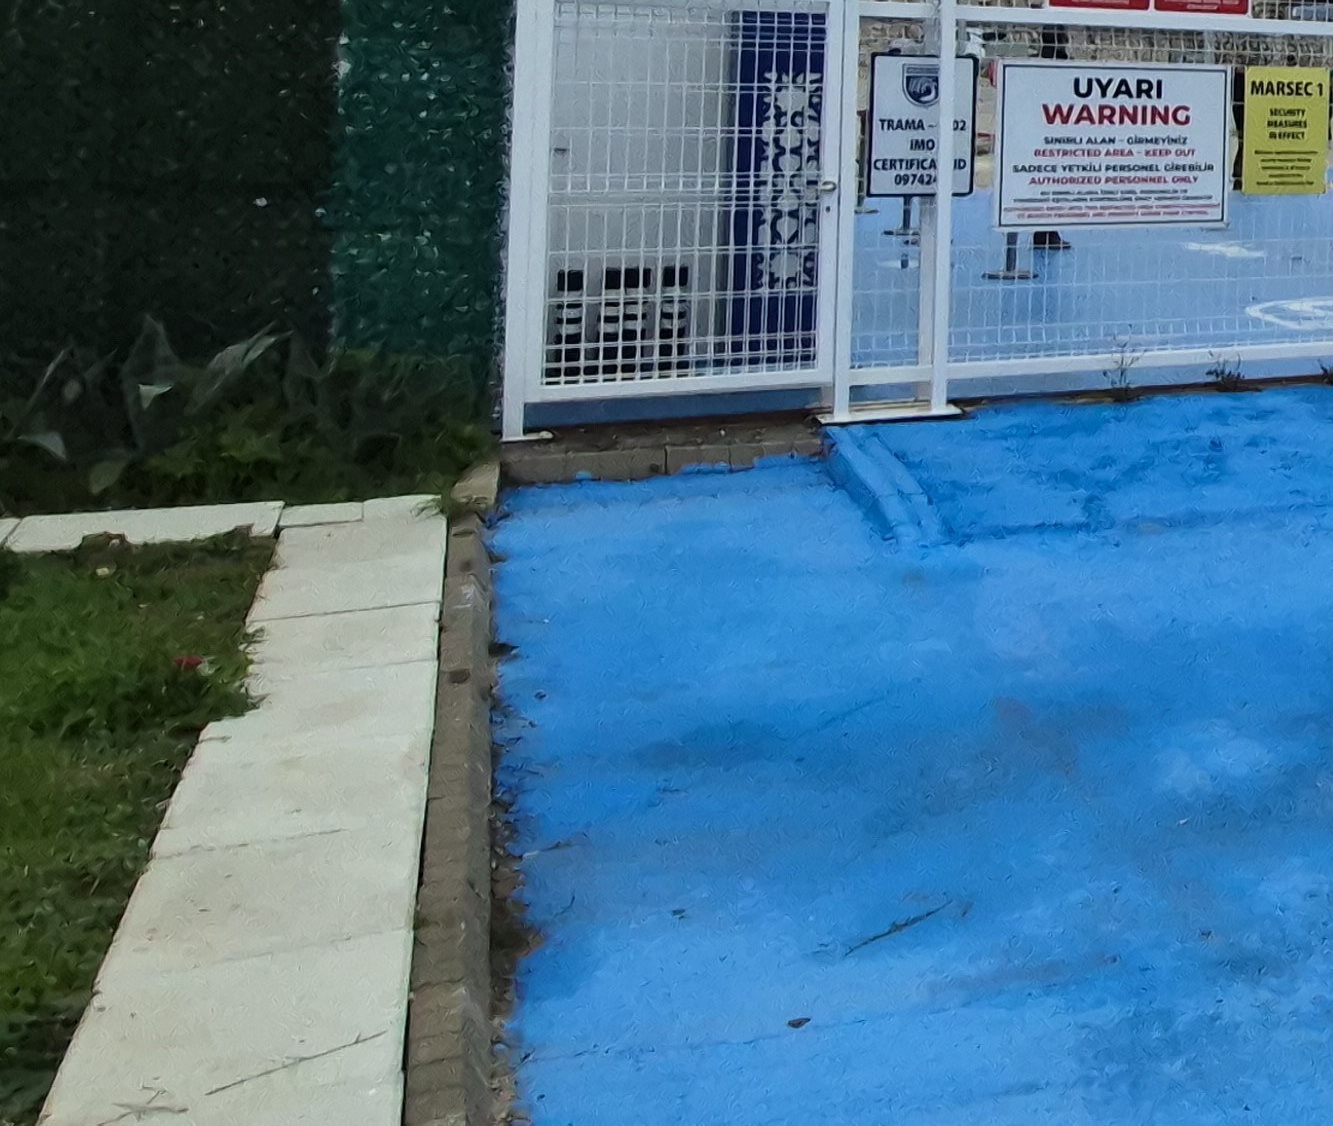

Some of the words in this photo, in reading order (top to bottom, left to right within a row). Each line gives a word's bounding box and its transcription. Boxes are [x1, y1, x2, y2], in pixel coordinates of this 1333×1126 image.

[1073, 77, 1163, 99] UYARI
[1250, 80, 1313, 96] MARSEC
[1317, 83, 1323, 96] 1
[1042, 104, 1191, 125] WARNING
[879, 119, 926, 131] TRAMA
[909, 138, 936, 151] IMO
[1087, 136, 1116, 145] ALAN
[1034, 148, 1101, 158] RESTRICTED
[1104, 148, 1134, 158] AREA
[1144, 148, 1172, 158] KEEP
[1174, 148, 1196, 157] OUT
[873, 159, 937, 170] CERTIFICA
[1013, 164, 1057, 173] SADECE
[1105, 163, 1160, 173] PERSONEL
[1029, 176, 1102, 186] AUTHORIZED
[1104, 175, 1168, 185] PERSONNEL
[1171, 175, 1198, 184] ONLY
